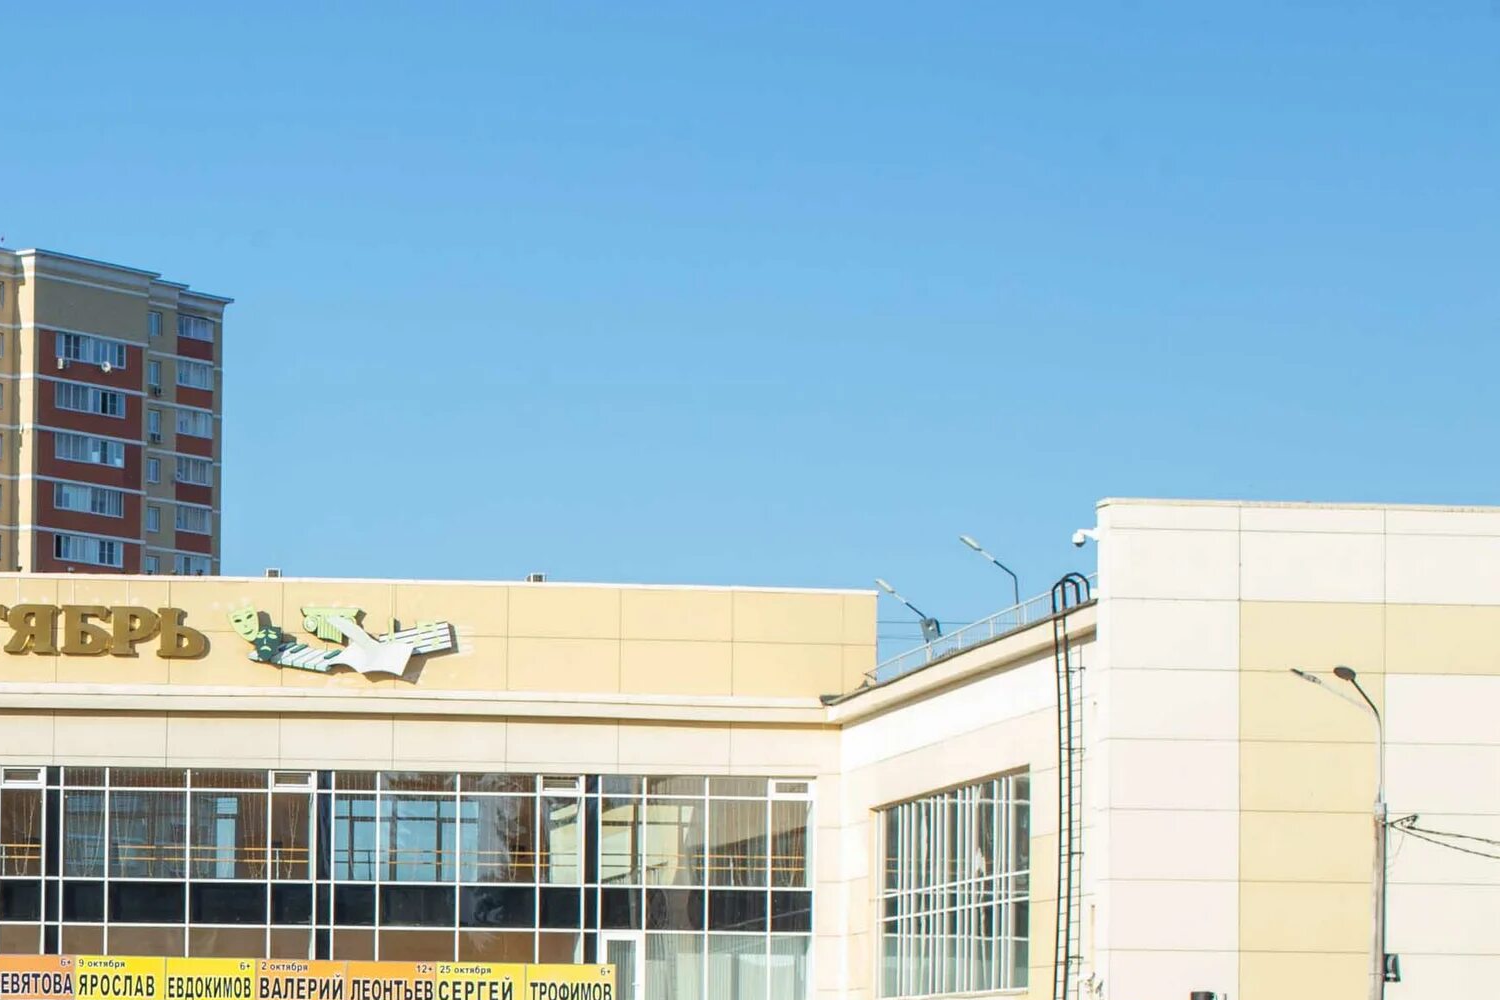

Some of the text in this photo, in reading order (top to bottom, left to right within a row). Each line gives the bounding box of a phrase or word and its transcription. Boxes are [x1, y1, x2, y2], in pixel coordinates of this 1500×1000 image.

[60, 958, 71, 967] 6+
[78, 959, 126, 969] 9 октября
[239, 962, 251, 971] 6+
[261, 962, 308, 972] 2 октября
[416, 965, 433, 973] 12+
[439, 965, 492, 975] 25 октября
[600, 967, 611, 976] 6+
[78, 974, 251, 1000] ЯРОСЛАВ ЕВДОКИМОВ
[259, 974, 434, 1000] ВАЛЕРИЙ ЛЕОНТЬЕВ
